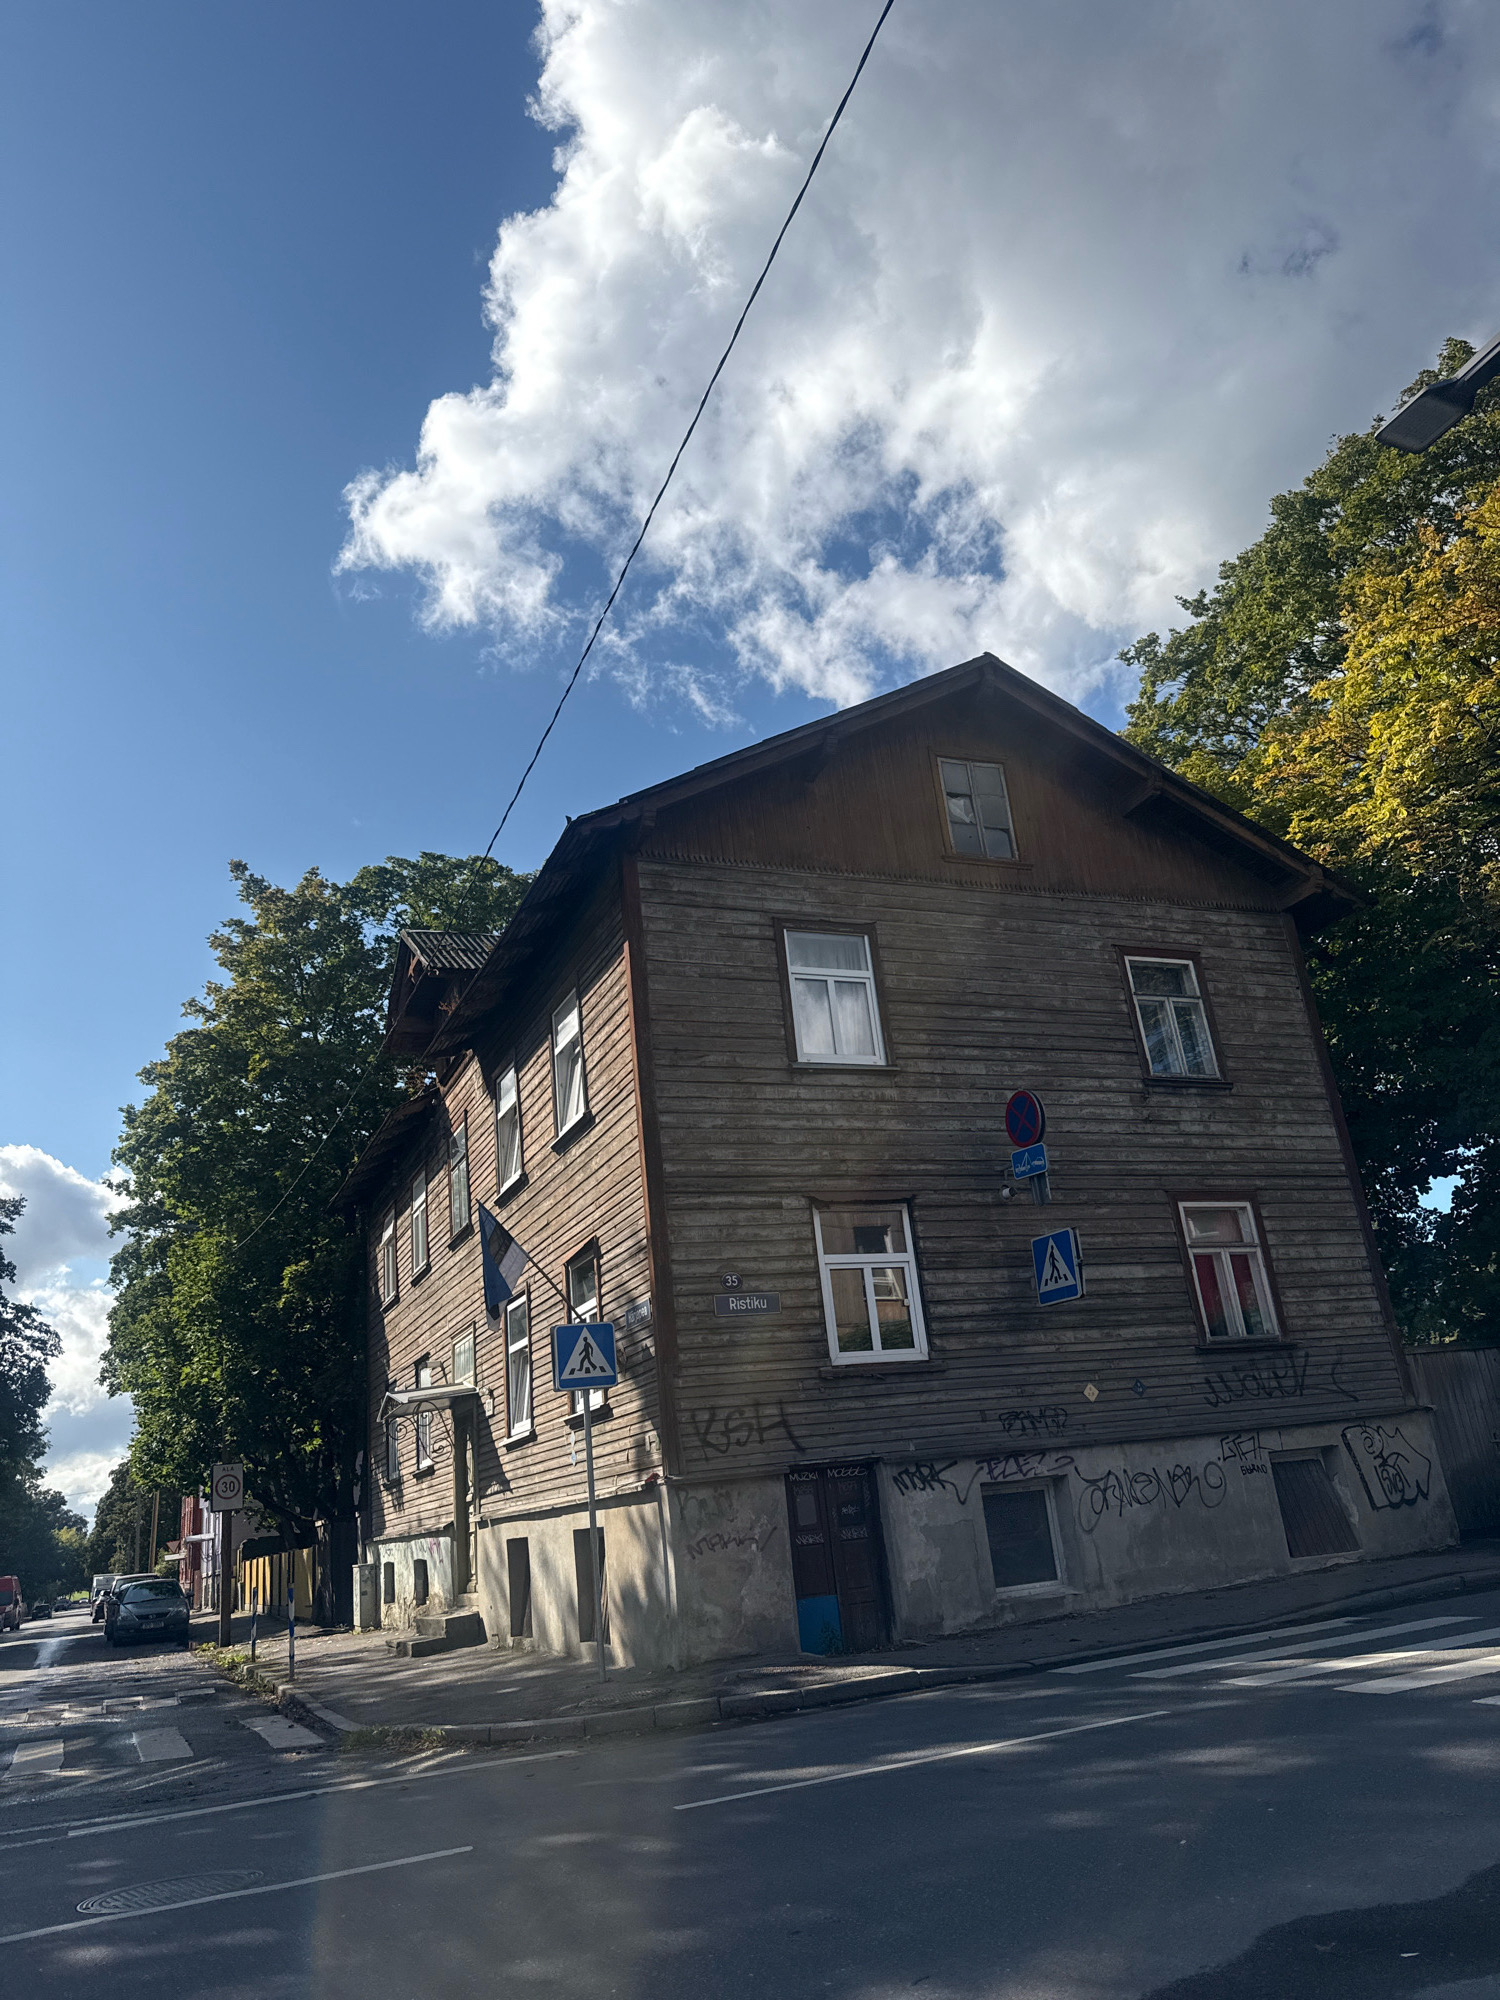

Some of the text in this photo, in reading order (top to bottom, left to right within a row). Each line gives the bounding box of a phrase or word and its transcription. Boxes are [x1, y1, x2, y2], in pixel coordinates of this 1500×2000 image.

[725, 1275, 738, 1286] 35
[729, 1296, 767, 1310] Ristiku
[221, 1481, 235, 1493] 30
